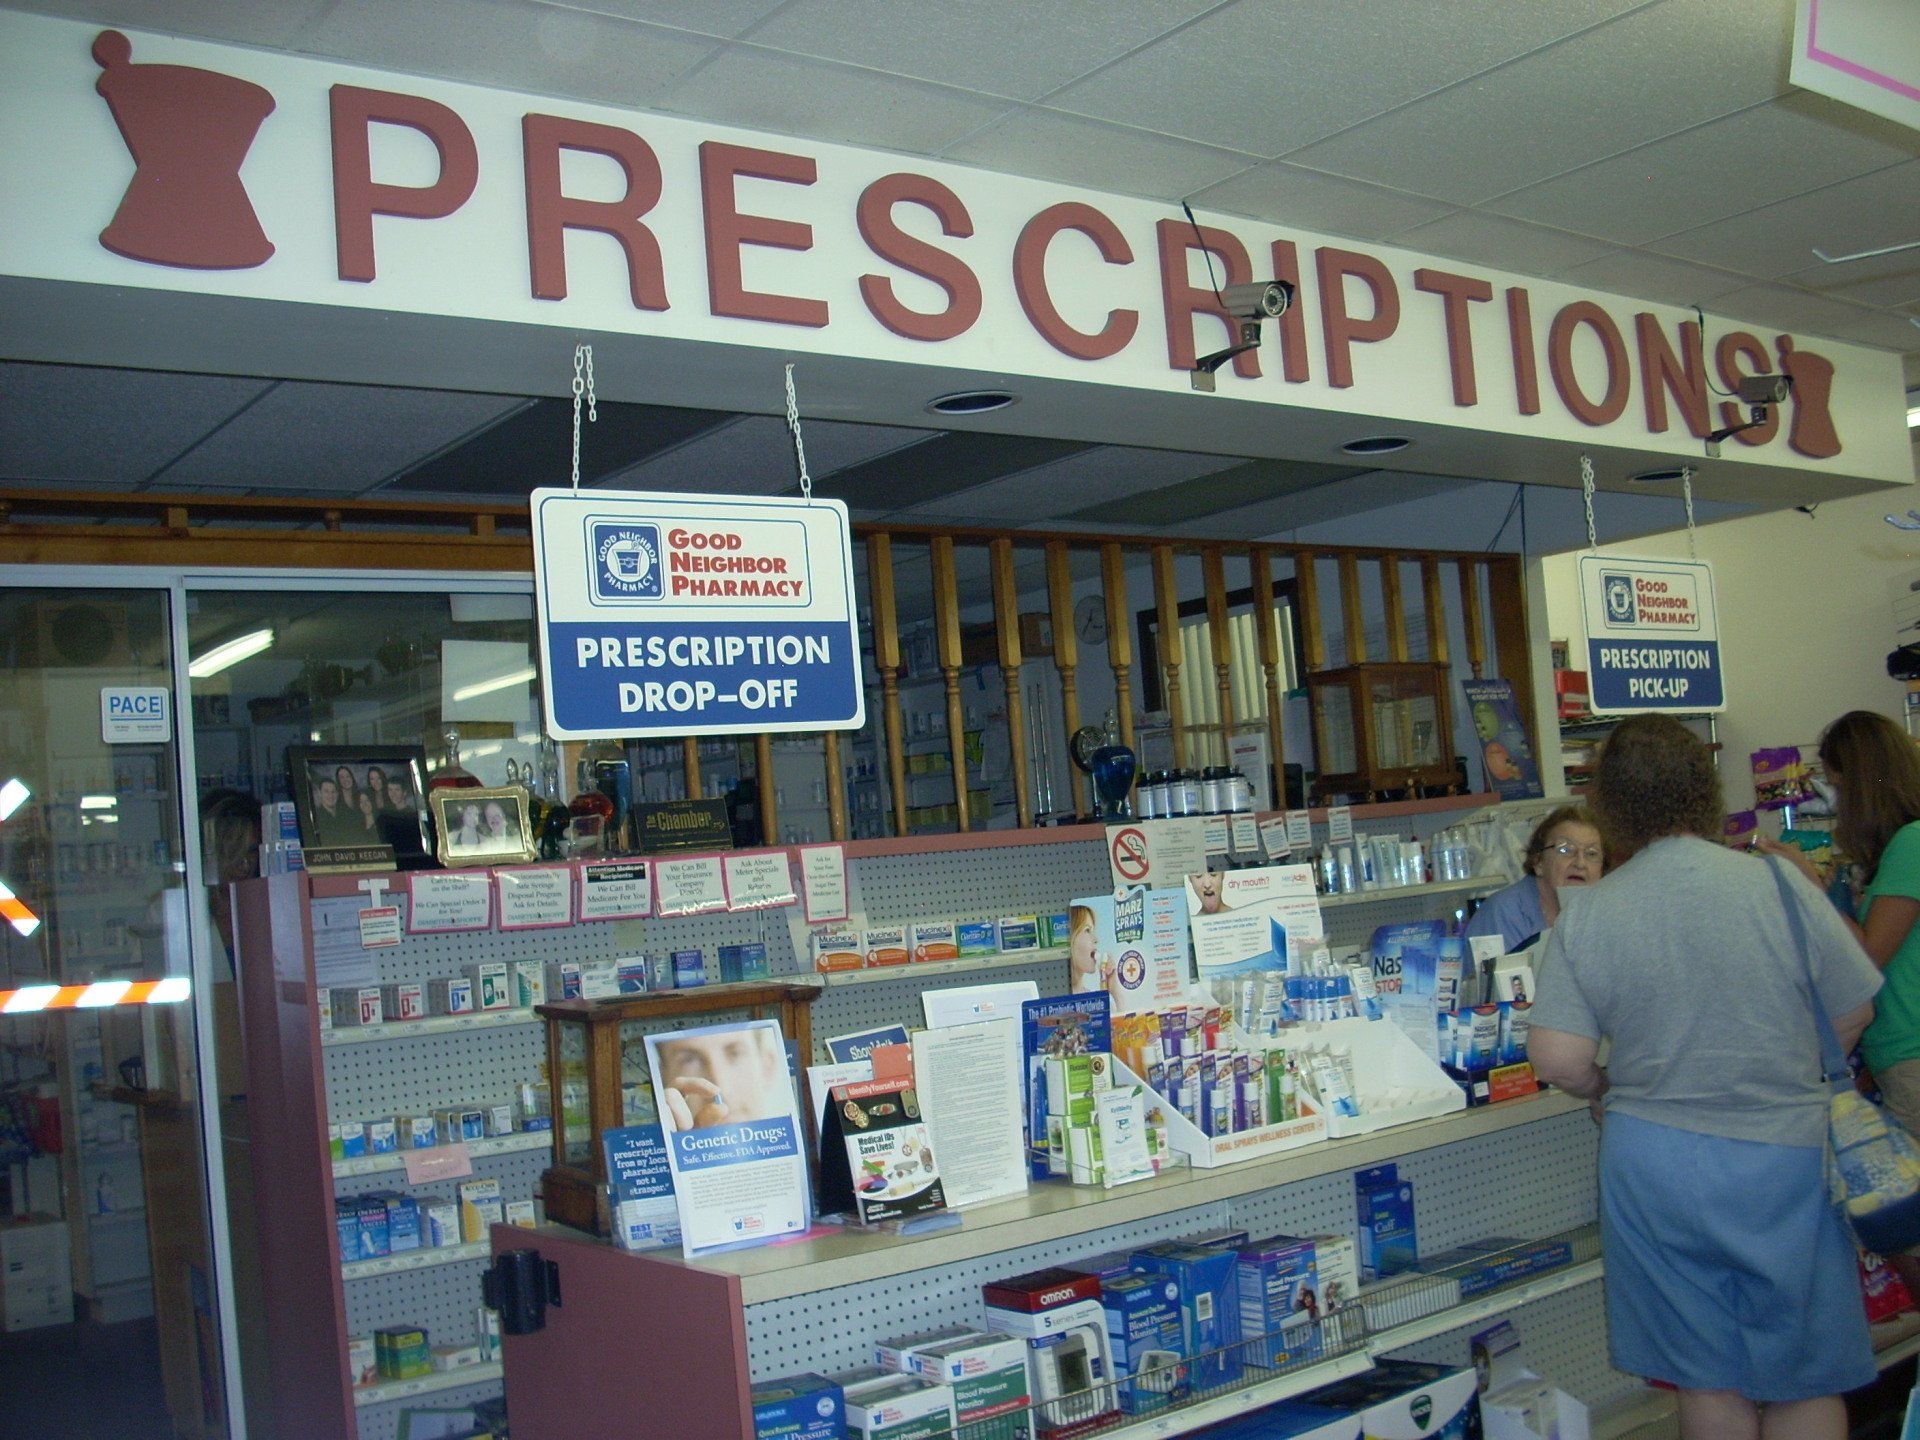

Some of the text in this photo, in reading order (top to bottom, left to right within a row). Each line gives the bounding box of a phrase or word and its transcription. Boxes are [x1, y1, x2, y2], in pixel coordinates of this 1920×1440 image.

[328, 82, 1782, 447] PRESCRIPTIONS
[667, 528, 742, 551] GOOD
[669, 552, 787, 574] NEIGHBOR
[672, 575, 804, 597] PHARMACY
[1635, 578, 1668, 593] GOOD
[1637, 593, 1688, 608] NEIGHBOR
[1638, 609, 1696, 625] PHARMACY
[576, 635, 831, 668] PRESCRIPTION
[1600, 648, 1711, 670] PRESCRIPTION
[618, 679, 799, 713] DROP-OFF
[1629, 677, 1689, 699] PICK-UP
[109, 696, 161, 714] PACE
[657, 811, 712, 831] Chamber
[1116, 899, 1142, 918] MARZ
[916, 926, 947, 935] Mucinex
[1116, 912, 1143, 931] SPRAYS
[820, 935, 852, 943] Mucinex
[866, 931, 897, 940] Mucinex
[1028, 1008, 1039, 1020] The
[1075, 999, 1105, 1012] Worldwide
[635, 1139, 654, 1147] want
[681, 1126, 787, 1151] Generic Drugs:
[857, 1135, 884, 1146] Medical
[859, 1145, 876, 1155] Save
[616, 1160, 636, 1169] from
[636, 1177, 650, 1186] not
[1374, 1218, 1395, 1233] Cuff
[1040, 1288, 1075, 1306] OMRON
[1044, 1317, 1052, 1328] 5
[956, 1382, 1008, 1399] Blood Pressure
